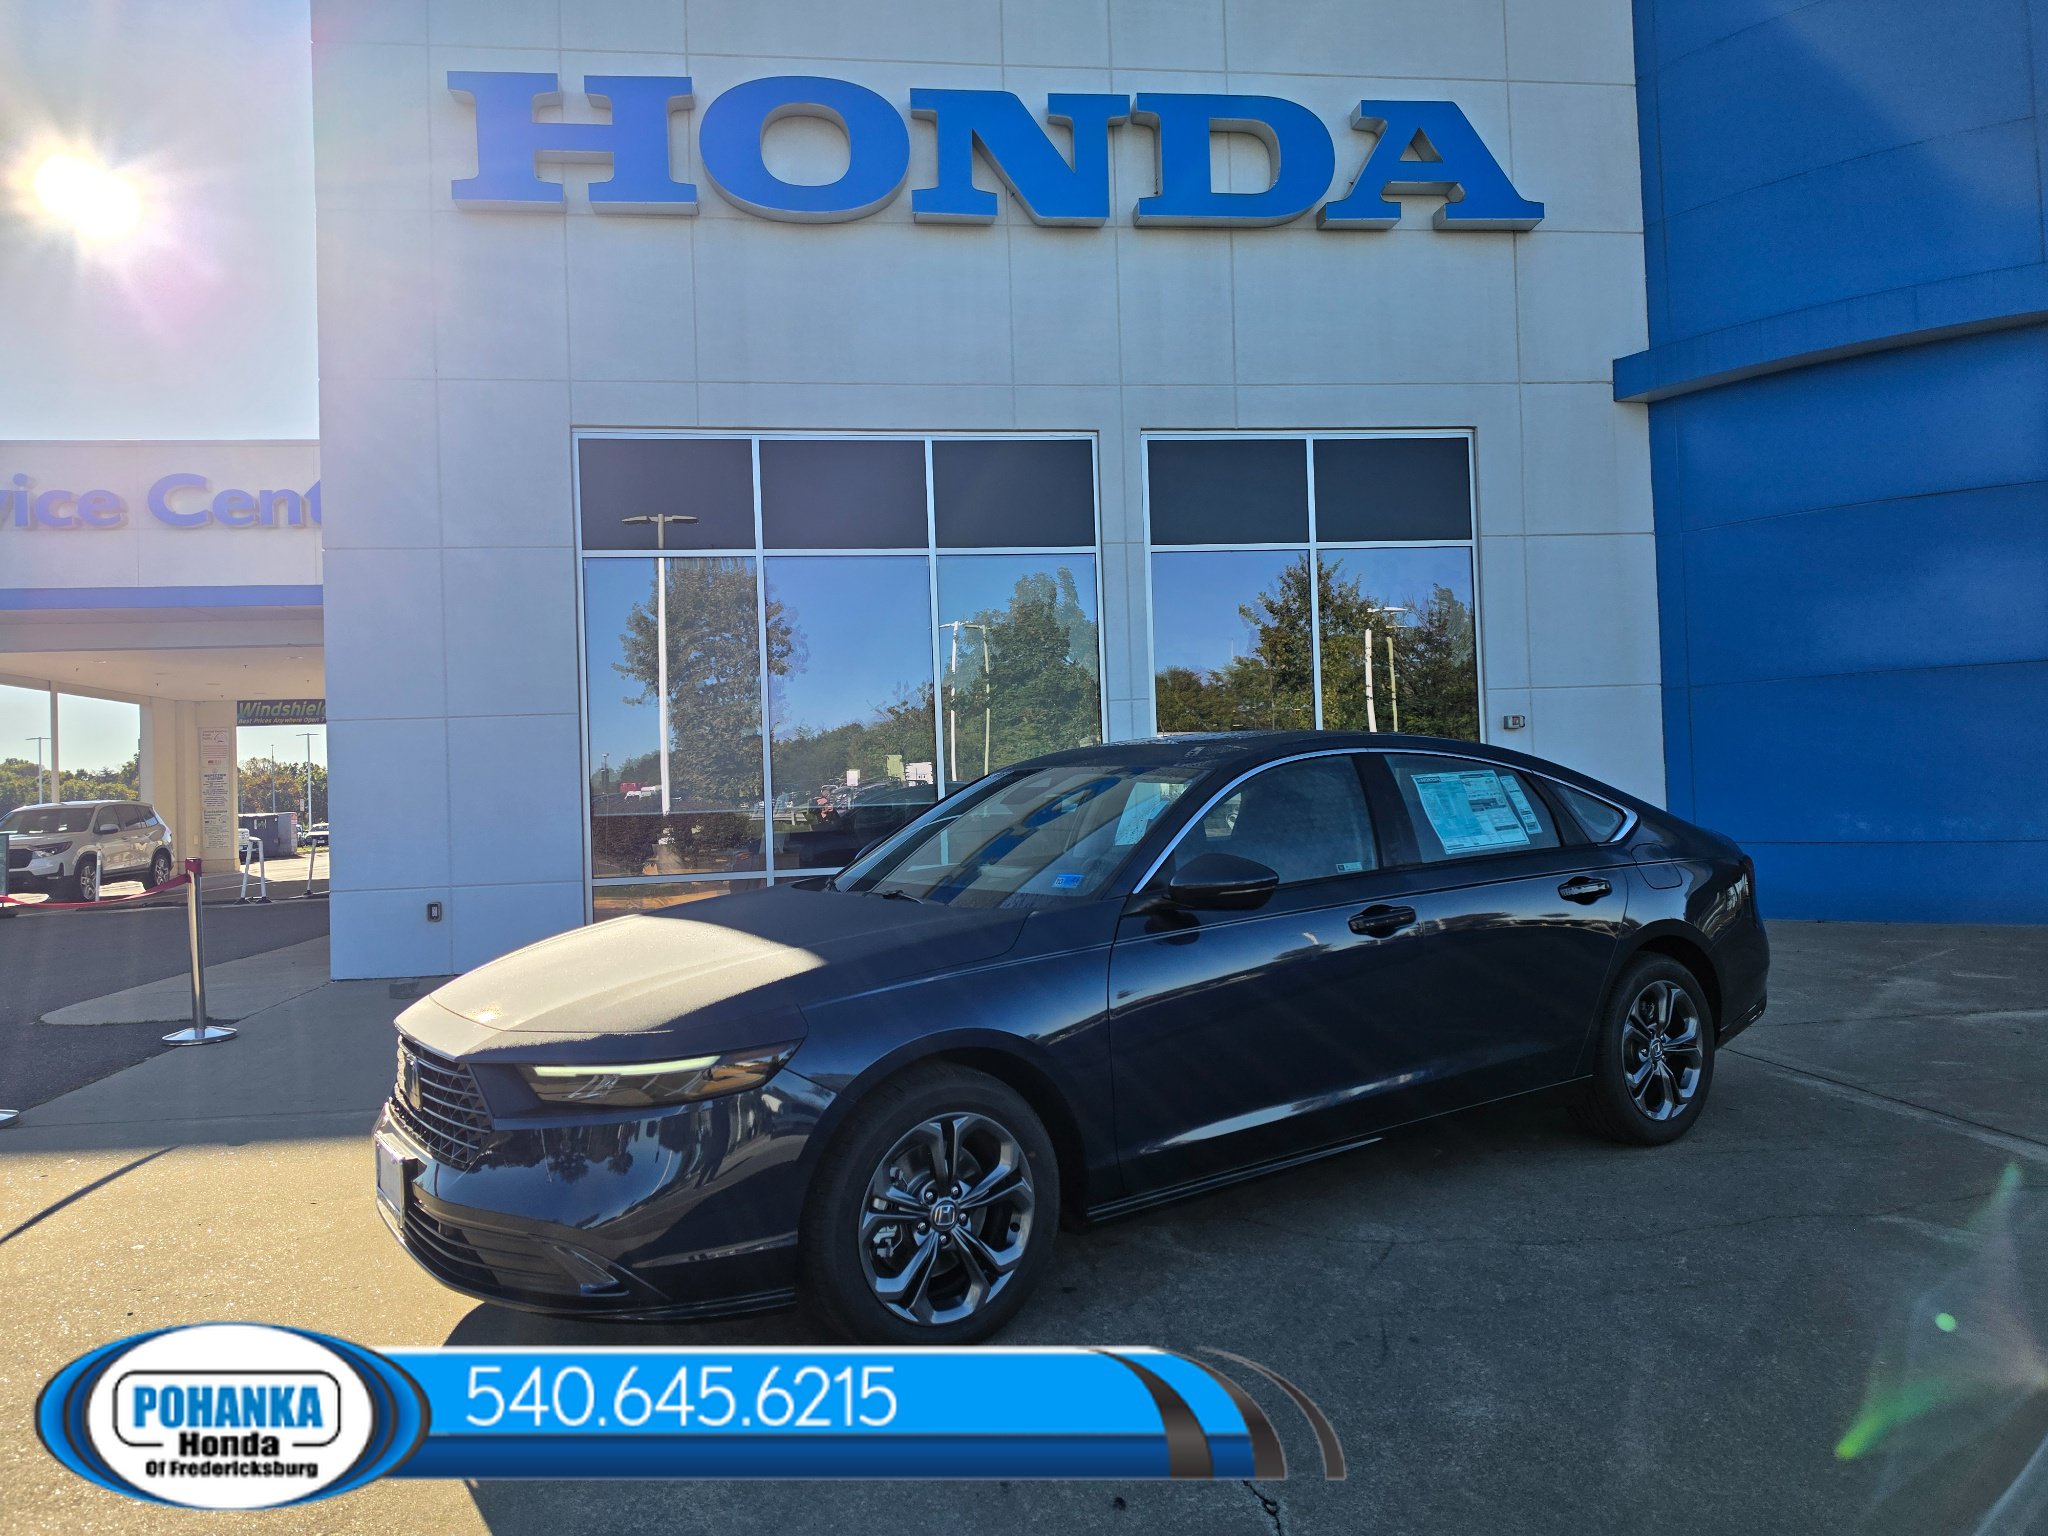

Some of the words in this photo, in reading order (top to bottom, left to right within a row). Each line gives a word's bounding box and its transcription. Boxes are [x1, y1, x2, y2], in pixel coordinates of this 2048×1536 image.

[447, 71, 1545, 230] HONDA
[254, 717, 272, 725] Prices
[272, 716, 303, 725] Anywhere
[303, 716, 319, 724] Open
